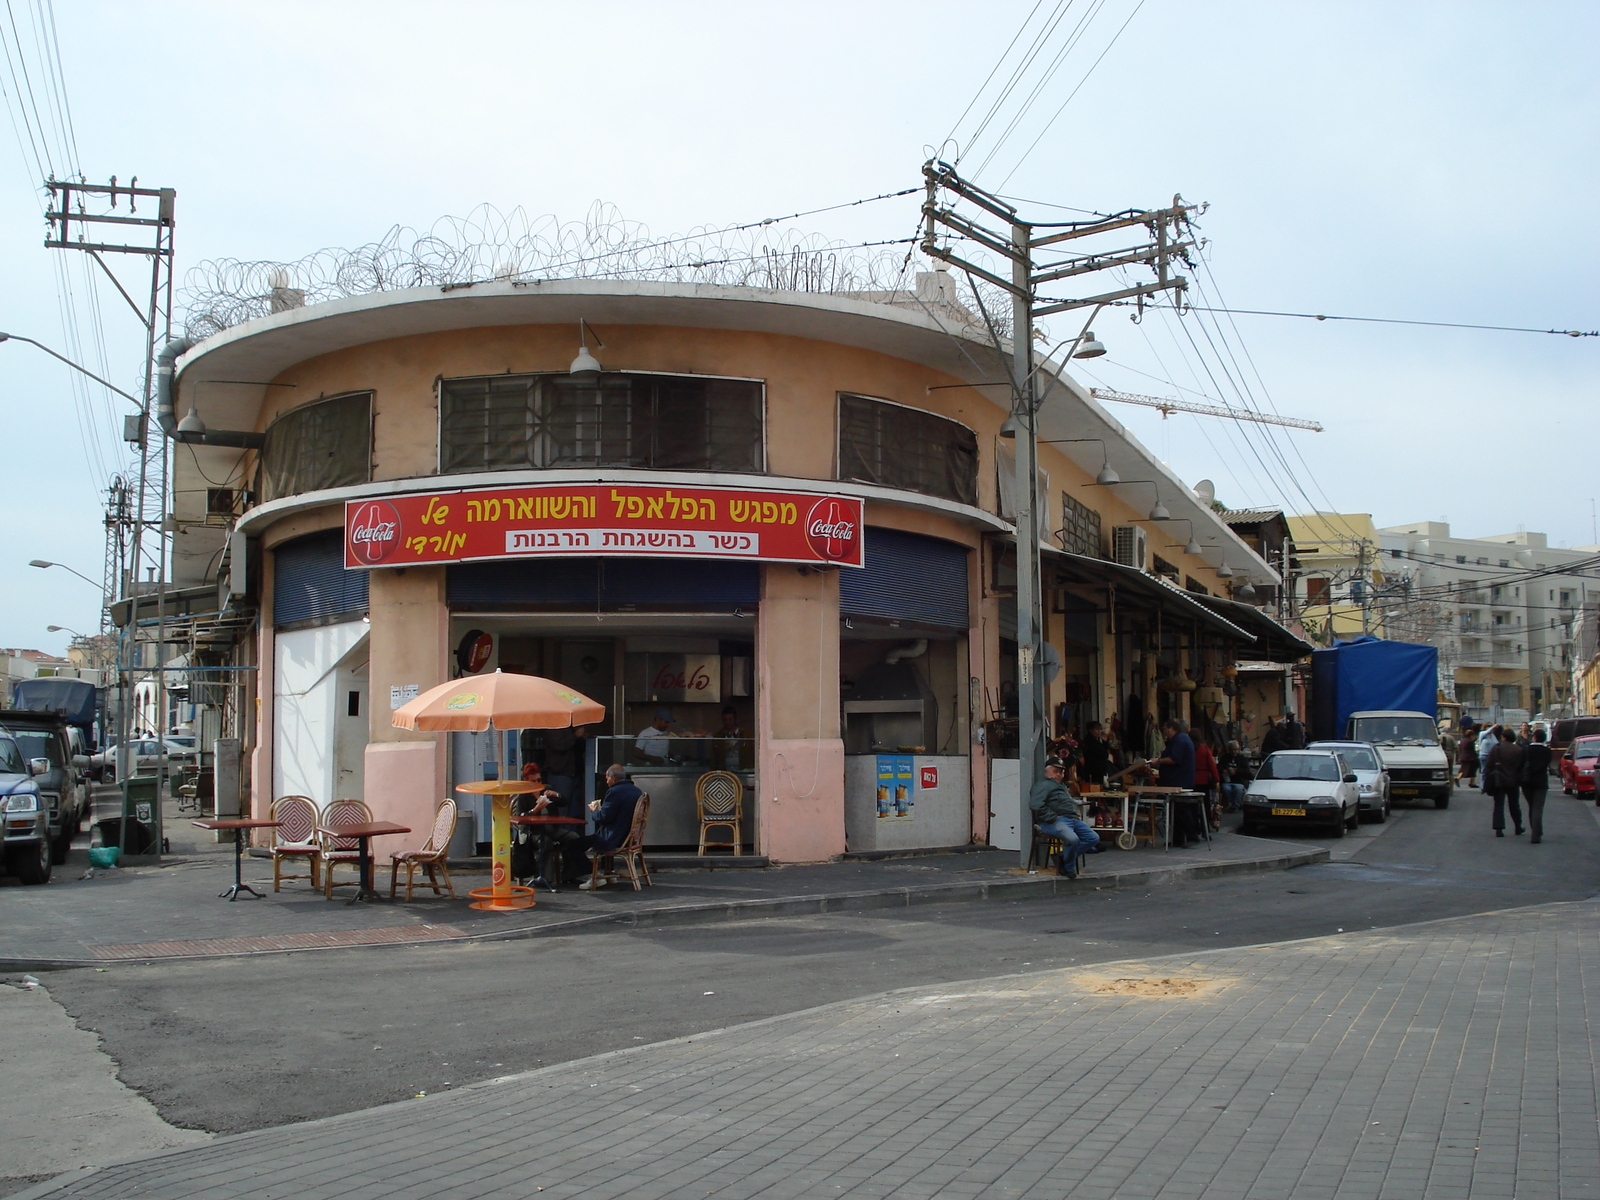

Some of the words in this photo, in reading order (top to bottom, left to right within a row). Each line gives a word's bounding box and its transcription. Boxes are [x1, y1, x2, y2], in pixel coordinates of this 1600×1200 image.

[421, 497, 450, 525] של
[467, 496, 596, 522] והשווארמה
[610, 489, 716, 520] הפלאפל
[729, 500, 798, 525] מפגש
[405, 530, 467, 556] מורדי
[513, 532, 589, 548] הרבנות
[602, 532, 696, 548] בהשגחת
[708, 534, 751, 550] כשר
[652, 664, 710, 690] פלאפל
